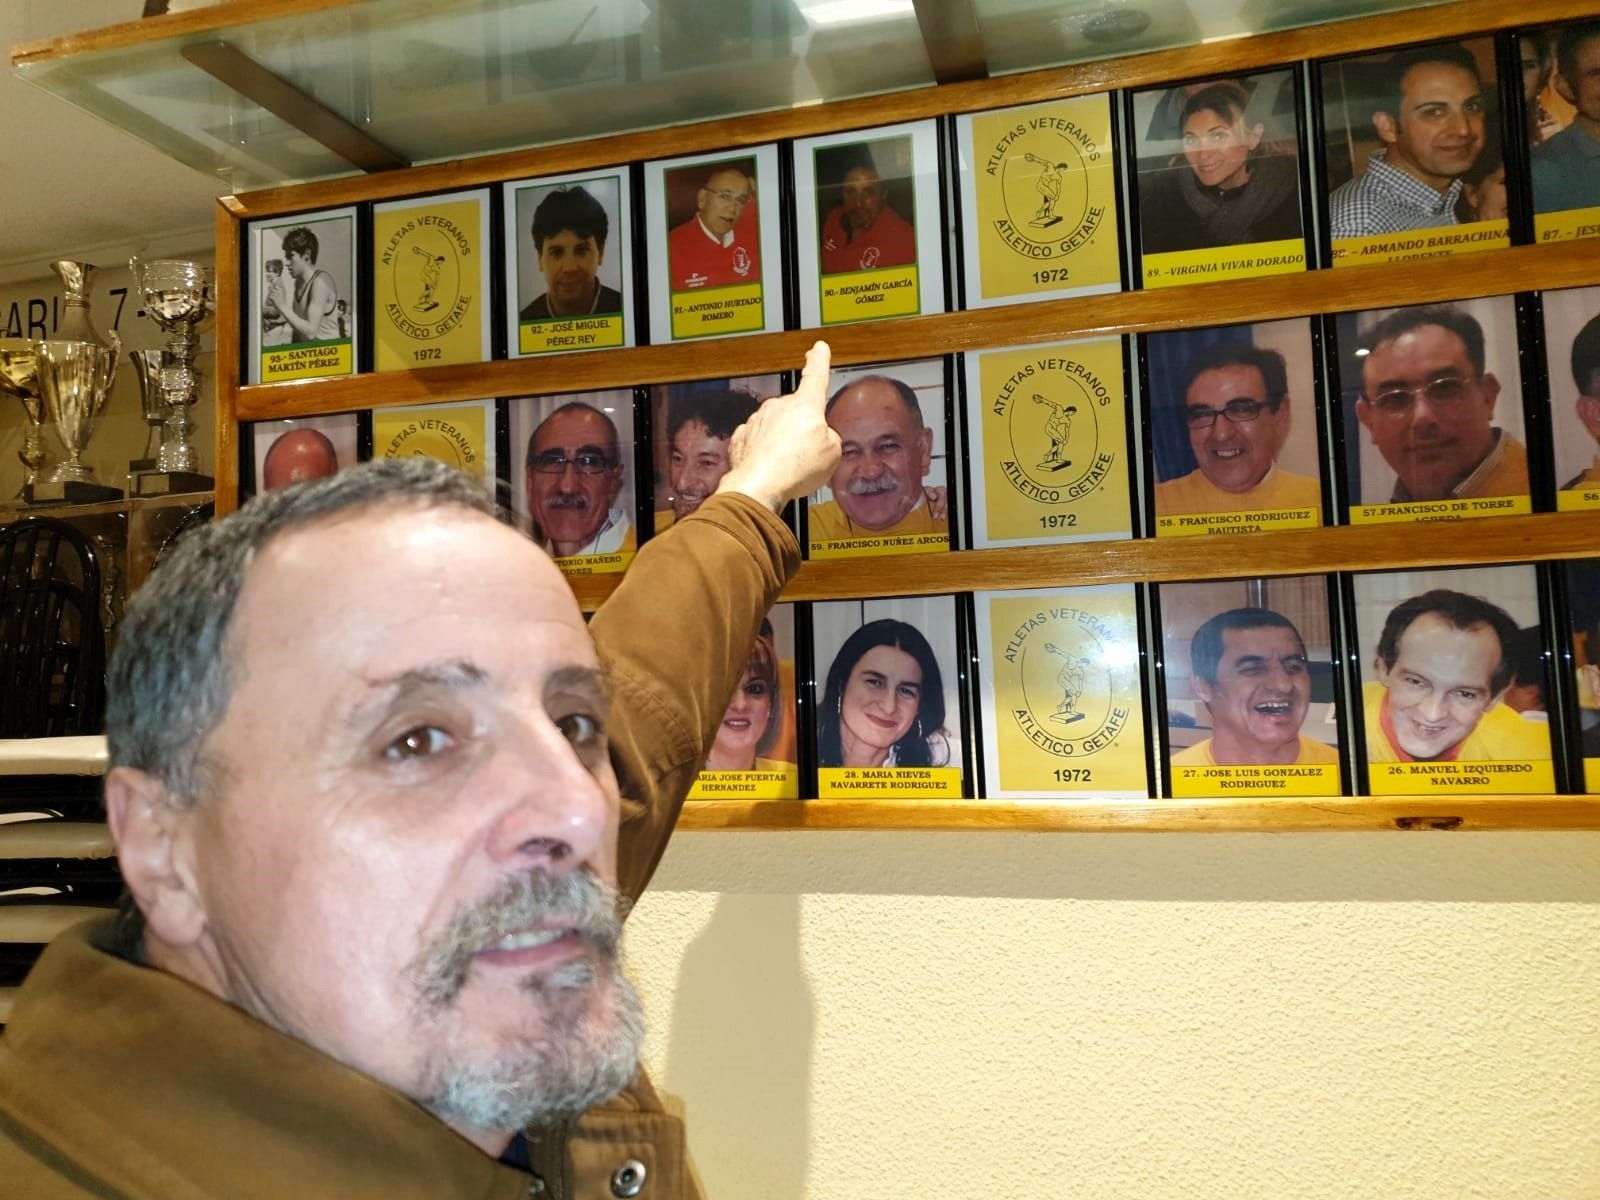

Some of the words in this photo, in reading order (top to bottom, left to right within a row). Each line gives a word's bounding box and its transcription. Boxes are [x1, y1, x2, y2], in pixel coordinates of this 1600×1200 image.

[986, 124, 1026, 176] ATLETAS
[1029, 117, 1101, 162] VETERANOS
[997, 220, 1052, 257] ATLETICO
[1060, 206, 1101, 253] GETAFE
[382, 221, 415, 265] ATLETAS
[417, 216, 471, 256] VETERANOS
[1361, 239, 1425, 256] ARMANDO
[1427, 228, 1511, 247] BARRACHINA
[1147, 269, 1162, 278] 89.
[1221, 260, 1253, 271] VIVAR
[1256, 254, 1304, 268] DORADO
[1032, 268, 1069, 284] 1972
[840, 282, 881, 296] BENJAMÍN
[882, 278, 912, 290] GARCÍA
[688, 301, 723, 313] ANTONIO
[724, 297, 762, 308] HURTADO
[388, 303, 430, 338] ATLETICO
[436, 295, 470, 335] GETAFE
[701, 311, 734, 322] ROMERO
[550, 320, 574, 333] JOSÉ
[576, 319, 611, 330] MIGUEL
[547, 335, 576, 347] PÉREZ
[578, 334, 597, 345] REY
[288, 347, 338, 360] SANTIAGO
[413, 348, 442, 361] 1972
[308, 357, 340, 369] PÉREZ
[993, 364, 1035, 416] ATLETAS
[1037, 358, 1111, 407] VETERANOS
[384, 424, 417, 459] TLETAS
[419, 419, 475, 463] VETERANOS
[1004, 460, 1060, 502] ATLETICO
[1068, 452, 1111, 498] GETAFE
[1452, 502, 1469, 512] DE
[1473, 499, 1514, 510] TORRE
[1039, 513, 1077, 529] 1972
[1160, 519, 1177, 527] 58.
[1179, 515, 1242, 526] FRANCISCO
[1245, 511, 1311, 523] RODRIGUEZ
[811, 543, 825, 551] 59.
[828, 539, 880, 550] FRANCISCO
[916, 535, 950, 545] ARCOS
[586, 555, 622, 565] MAÑERO
[1005, 612, 1047, 663] ATLETAS
[1050, 607, 1120, 646] VETERAN
[1015, 708, 1074, 755] ATLETICO
[1082, 707, 1126, 753] GETAFE
[845, 771, 859, 779] 28.
[862, 771, 893, 779] MARIA
[896, 771, 931, 779] NIEVES
[1053, 768, 1092, 782] 1972
[1184, 769, 1200, 778] 27.
[1203, 769, 1232, 778] JOSE
[1235, 769, 1260, 777] LUIS
[1263, 768, 1323, 777] GONZALEZ
[1388, 766, 1406, 775] 26.
[1410, 765, 1460, 775] MANUEL
[1463, 764, 1532, 775] IZQUIERDO
[697, 774, 717, 782] ARIA
[720, 774, 743, 782] JOSE
[745, 773, 787, 782] PUERTAS
[1220, 780, 1286, 789] RODRIGUEZ
[1431, 776, 1490, 786] NAVARRO
[702, 784, 756, 792] HERNANDEZ
[830, 781, 887, 789] NAVARRETE
[890, 781, 948, 790] RODRIGUEZ
